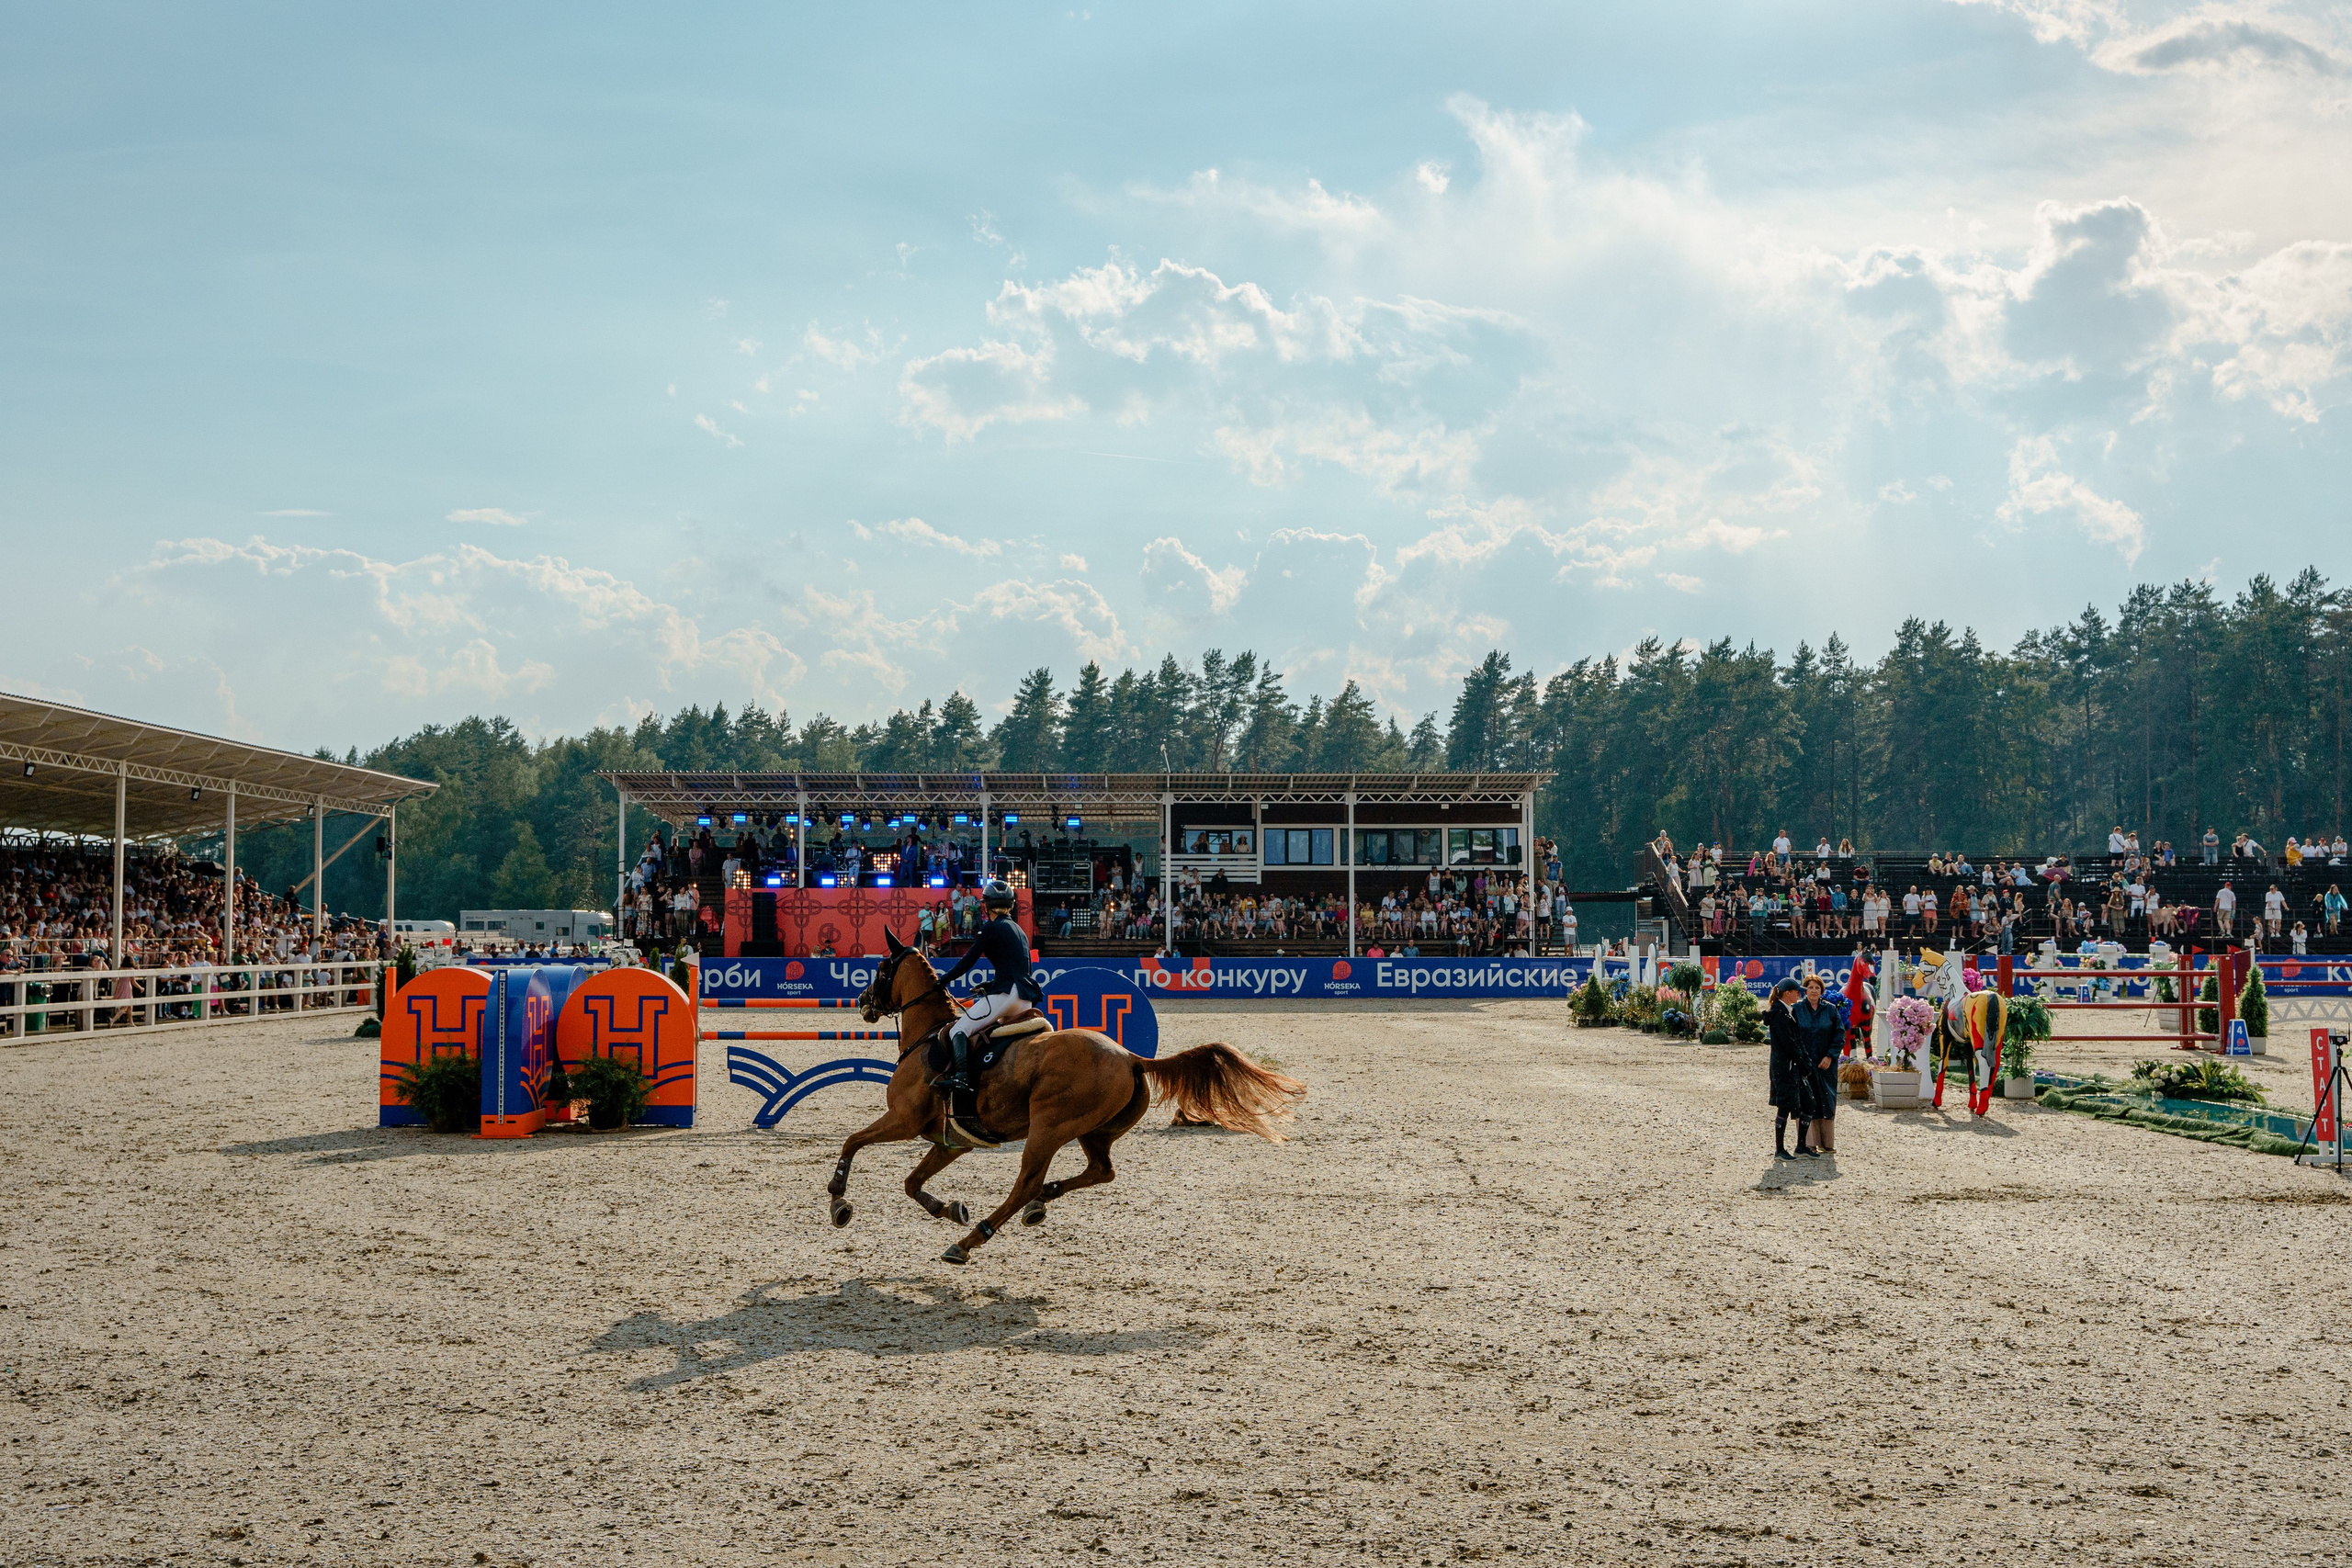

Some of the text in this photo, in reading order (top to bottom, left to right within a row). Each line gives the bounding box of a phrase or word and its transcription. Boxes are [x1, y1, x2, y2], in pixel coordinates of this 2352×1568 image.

[1134, 969, 1171, 987] по
[1182, 969, 1307, 994] конкуру
[1377, 962, 1578, 994] Евразийские
[776, 981, 814, 990] HÓRSEKA
[1324, 981, 1361, 990] HÓRSEKA
[2236, 1025, 2244, 1035] 4
